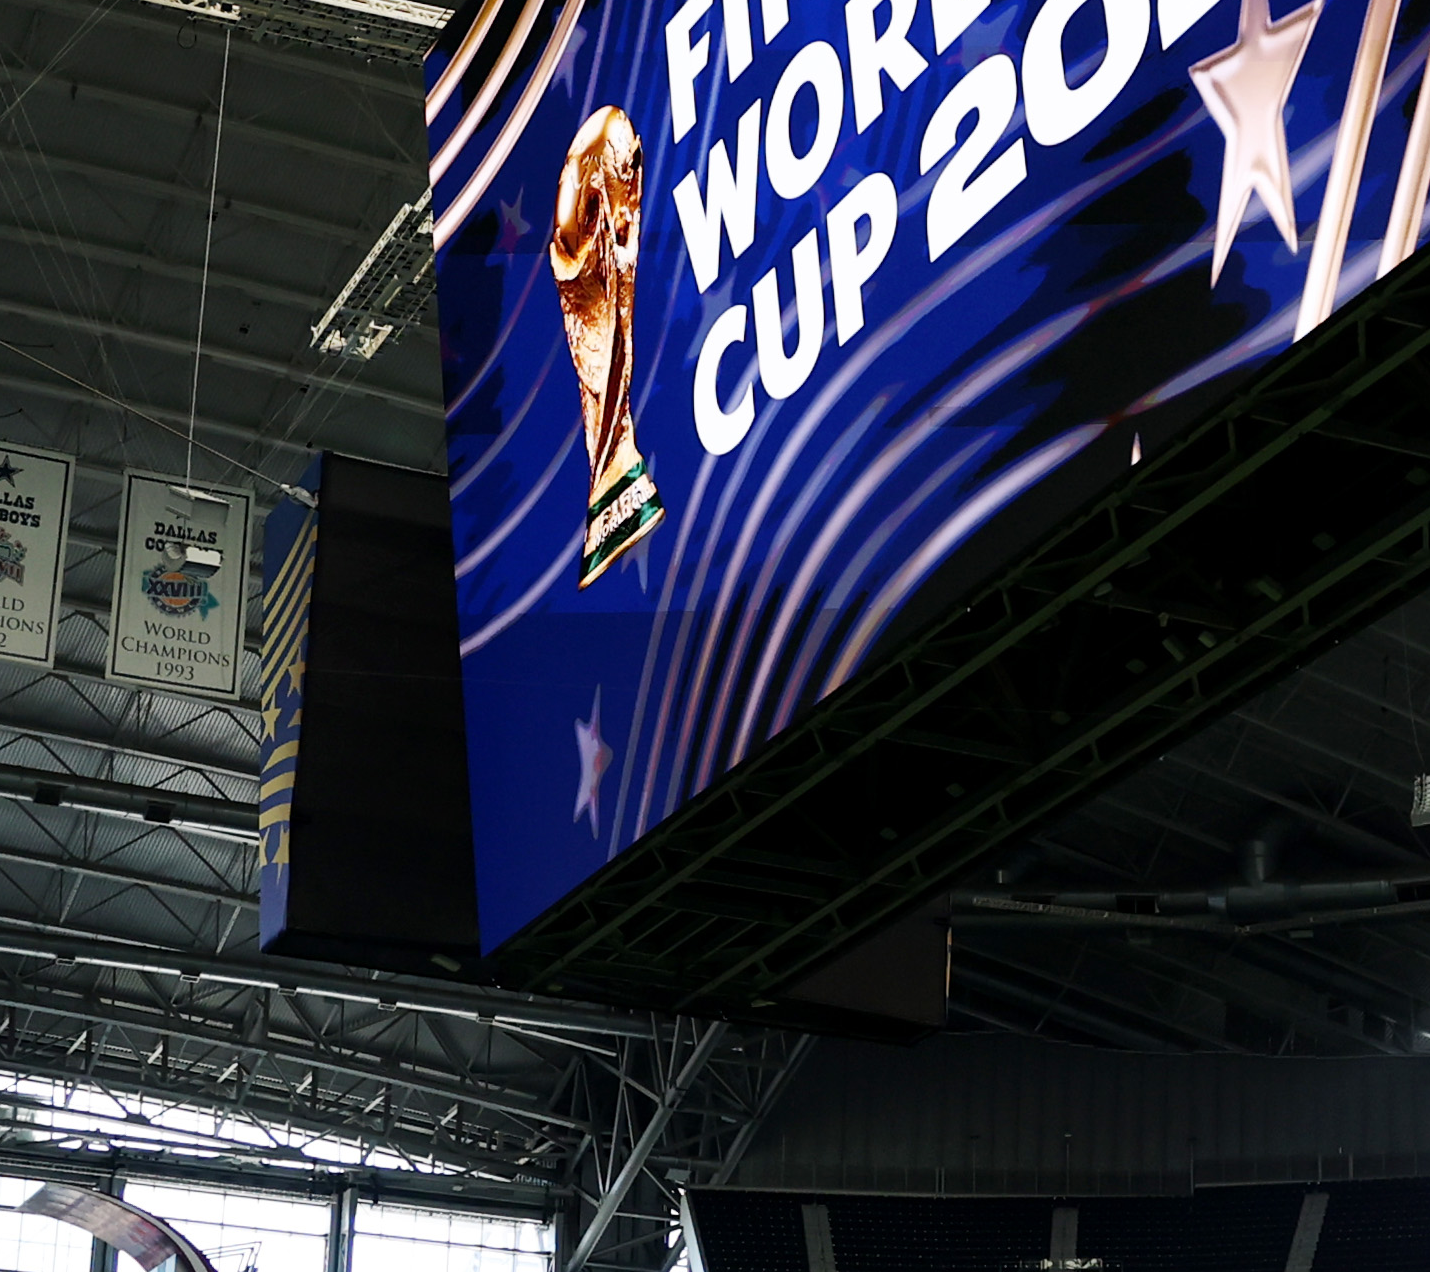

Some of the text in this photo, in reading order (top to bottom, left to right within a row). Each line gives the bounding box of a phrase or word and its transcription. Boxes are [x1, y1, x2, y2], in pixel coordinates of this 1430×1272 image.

[694, 173, 897, 455] CUP
[154, 521, 217, 545] DALLAS
[144, 620, 211, 645] WORLD
[121, 637, 230, 668] CHAMPIONS
[154, 661, 194, 681] 1993
